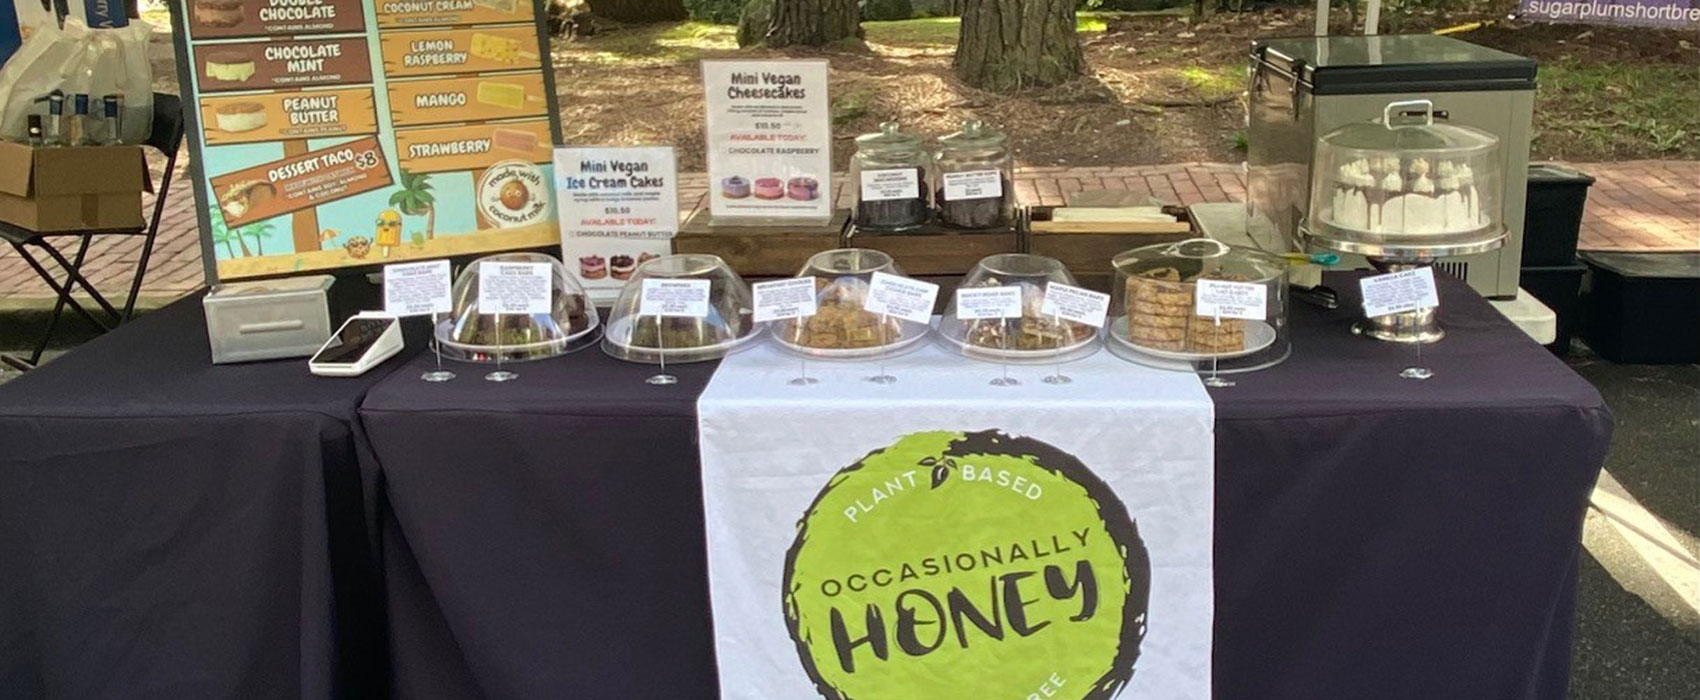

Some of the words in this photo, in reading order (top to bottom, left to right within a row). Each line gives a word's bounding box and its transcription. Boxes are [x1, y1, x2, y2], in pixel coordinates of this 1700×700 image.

[259, 6, 336, 21] CHOCOLATE
[384, 2, 432, 13] COCONUT
[436, 1, 473, 11] CREAM
[264, 44, 341, 60] CHOCOLATE
[411, 40, 453, 52] LEMON
[287, 59, 324, 73] MINT
[404, 53, 468, 66] RASPBERRY
[731, 72, 758, 85] Mini
[762, 72, 801, 89] Vegan
[416, 93, 466, 107] MANGO
[727, 86, 805, 99] Cheesecakes
[283, 96, 338, 111] PEANUT
[290, 110, 339, 125] BUTTER
[408, 139, 491, 158] STRAWBERRY
[267, 156, 321, 183] DESSERT
[321, 149, 354, 168] TACO
[354, 150, 380, 170] $8
[580, 161, 607, 172] Mini
[610, 160, 648, 176] Vegan
[489, 168, 516, 188] made
[519, 170, 541, 186] with
[567, 177, 585, 189] Ice
[588, 177, 627, 189] Cream
[630, 176, 664, 188] Cakes
[489, 205, 527, 223] coconut
[528, 201, 546, 220] milk
[844, 470, 917, 523] PLANT
[962, 465, 1043, 500] BASED
[821, 527, 1090, 597] OCCASIONALLY
[829, 559, 1098, 673] HONEY
